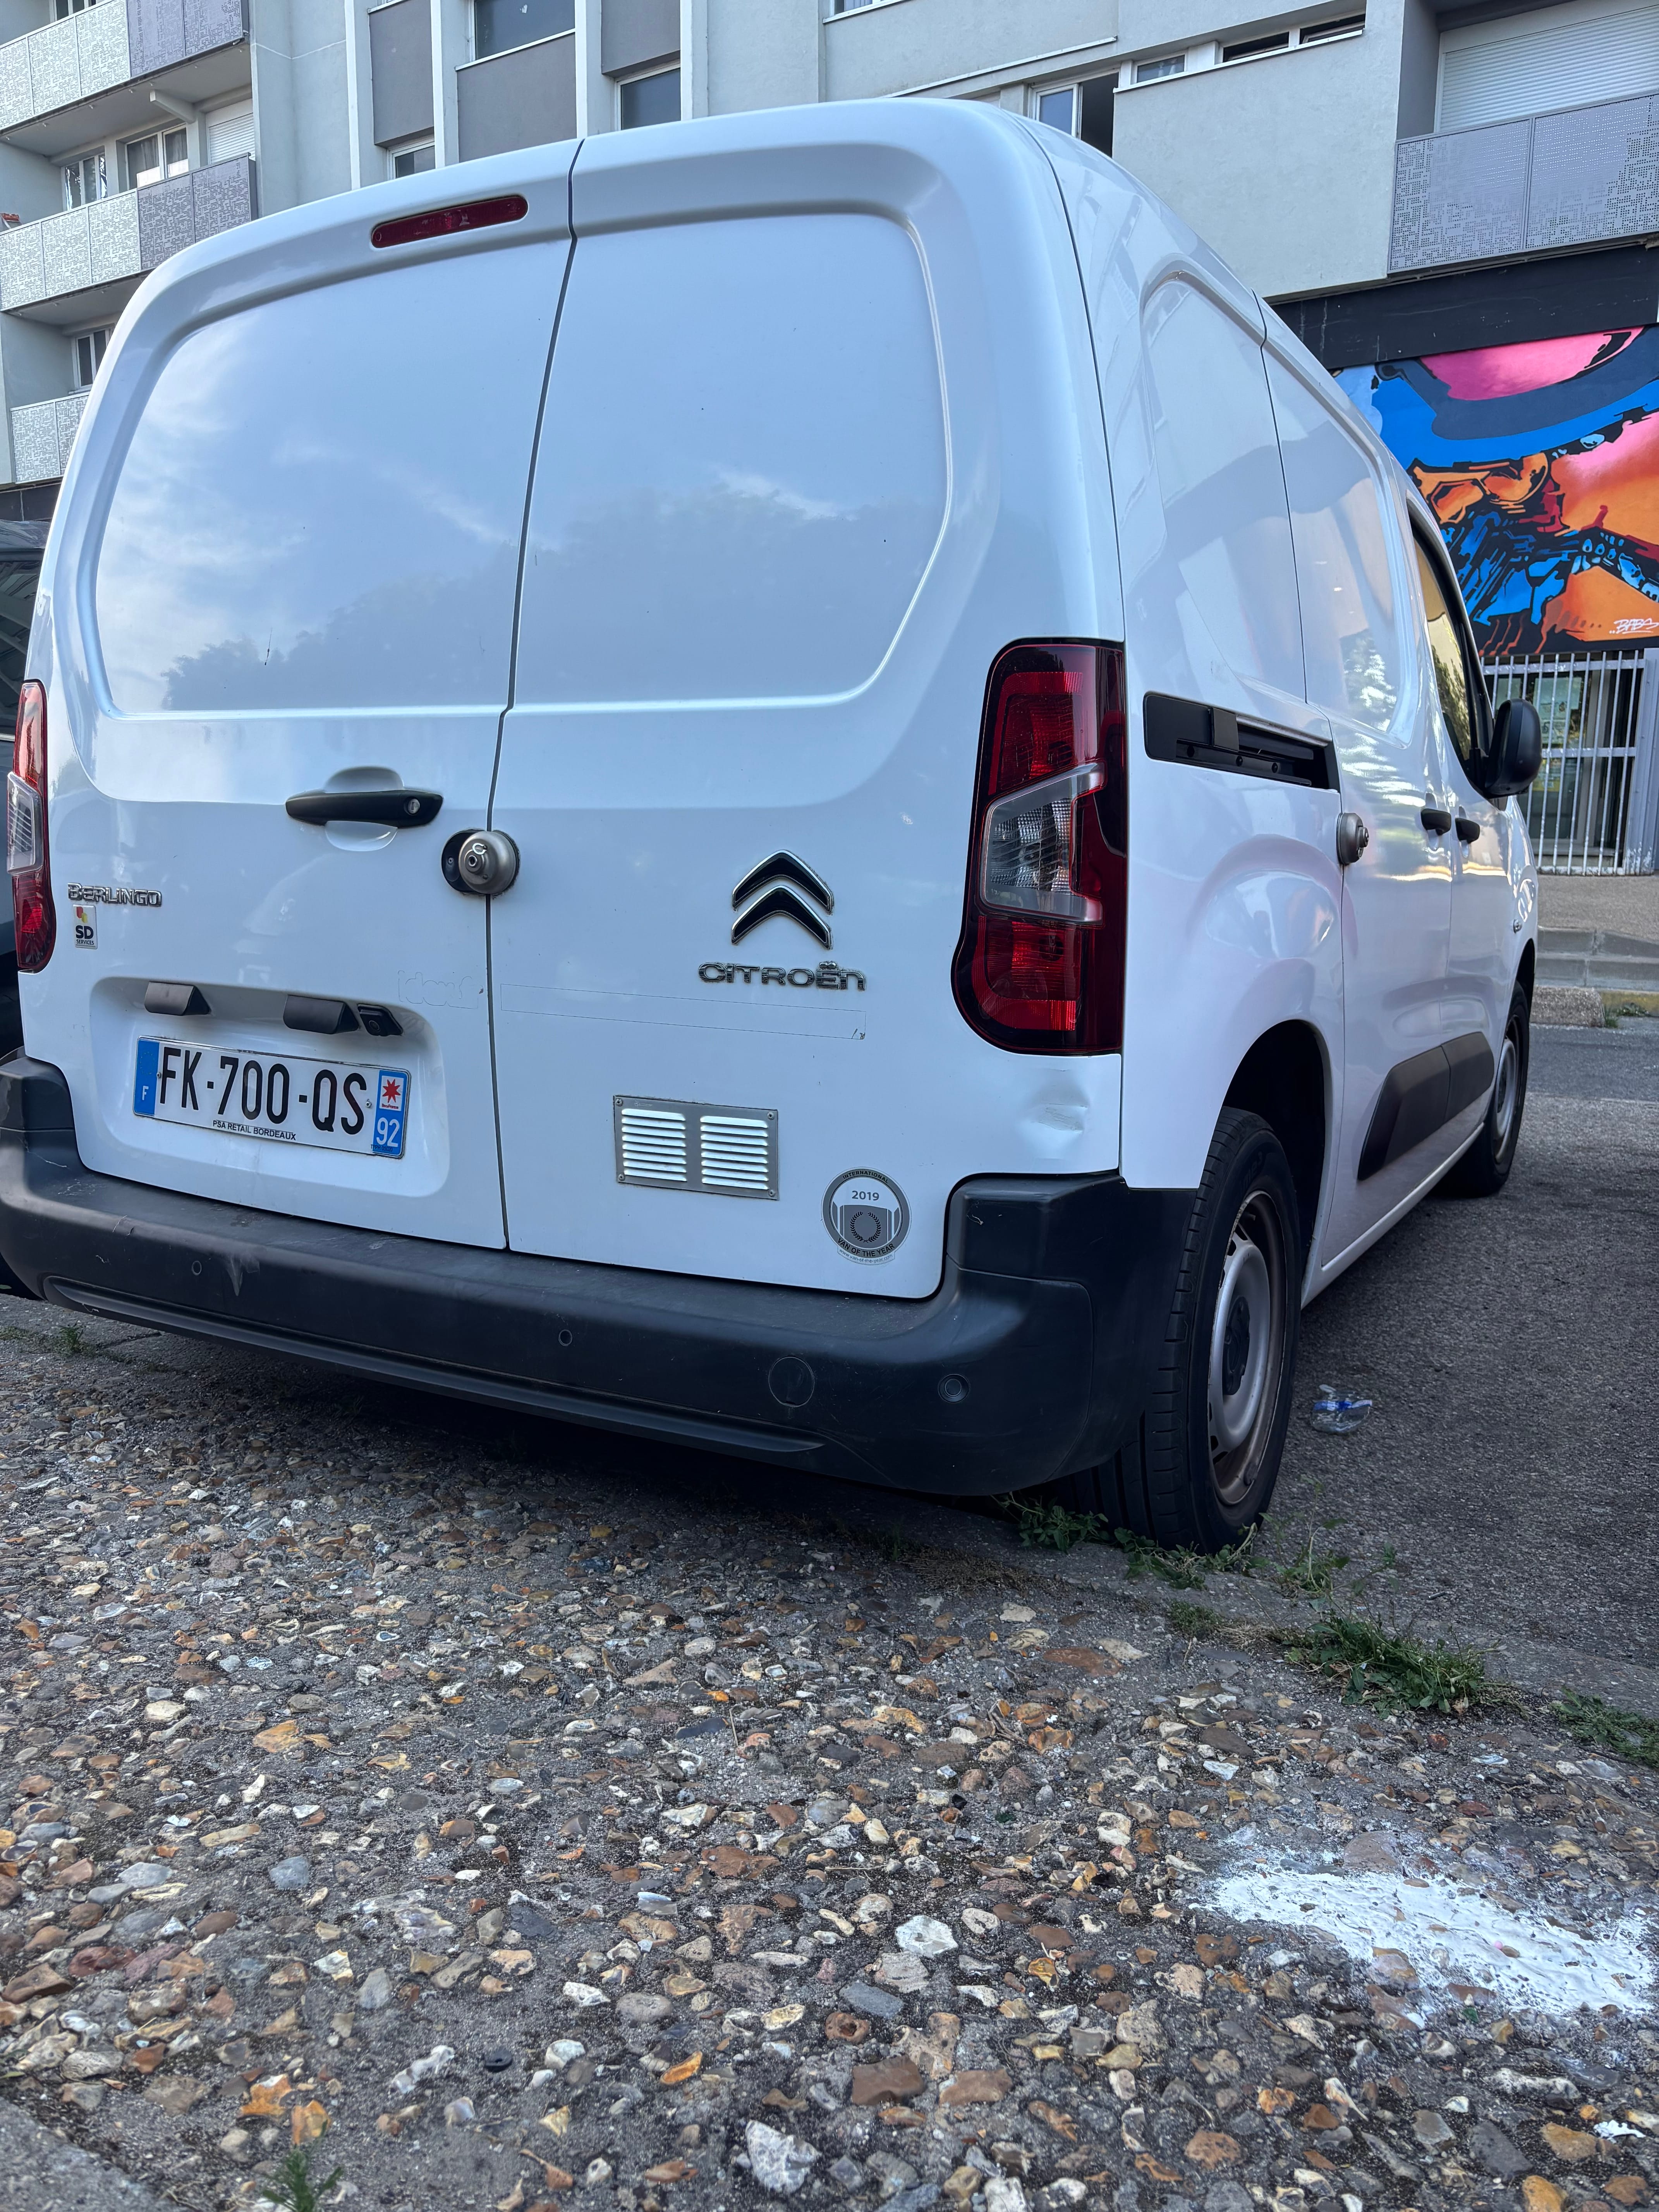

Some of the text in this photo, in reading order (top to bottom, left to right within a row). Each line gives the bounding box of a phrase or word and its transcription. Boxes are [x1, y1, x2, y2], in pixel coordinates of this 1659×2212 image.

[67, 883, 162, 907] BERLINGO
[76, 925, 94, 939] SD
[142, 1085, 149, 1101] F
[160, 1046, 367, 1135] FK-700-QS
[213, 1120, 296, 1140] PSA RETAIL BORDEAUX
[376, 1117, 400, 1147] 92
[843, 1170, 888, 1183] INTERNATIONAL
[852, 1190, 879, 1200] 2019
[838, 1237, 850, 1250] VAN
[877, 1243, 895, 1255] YEAR
